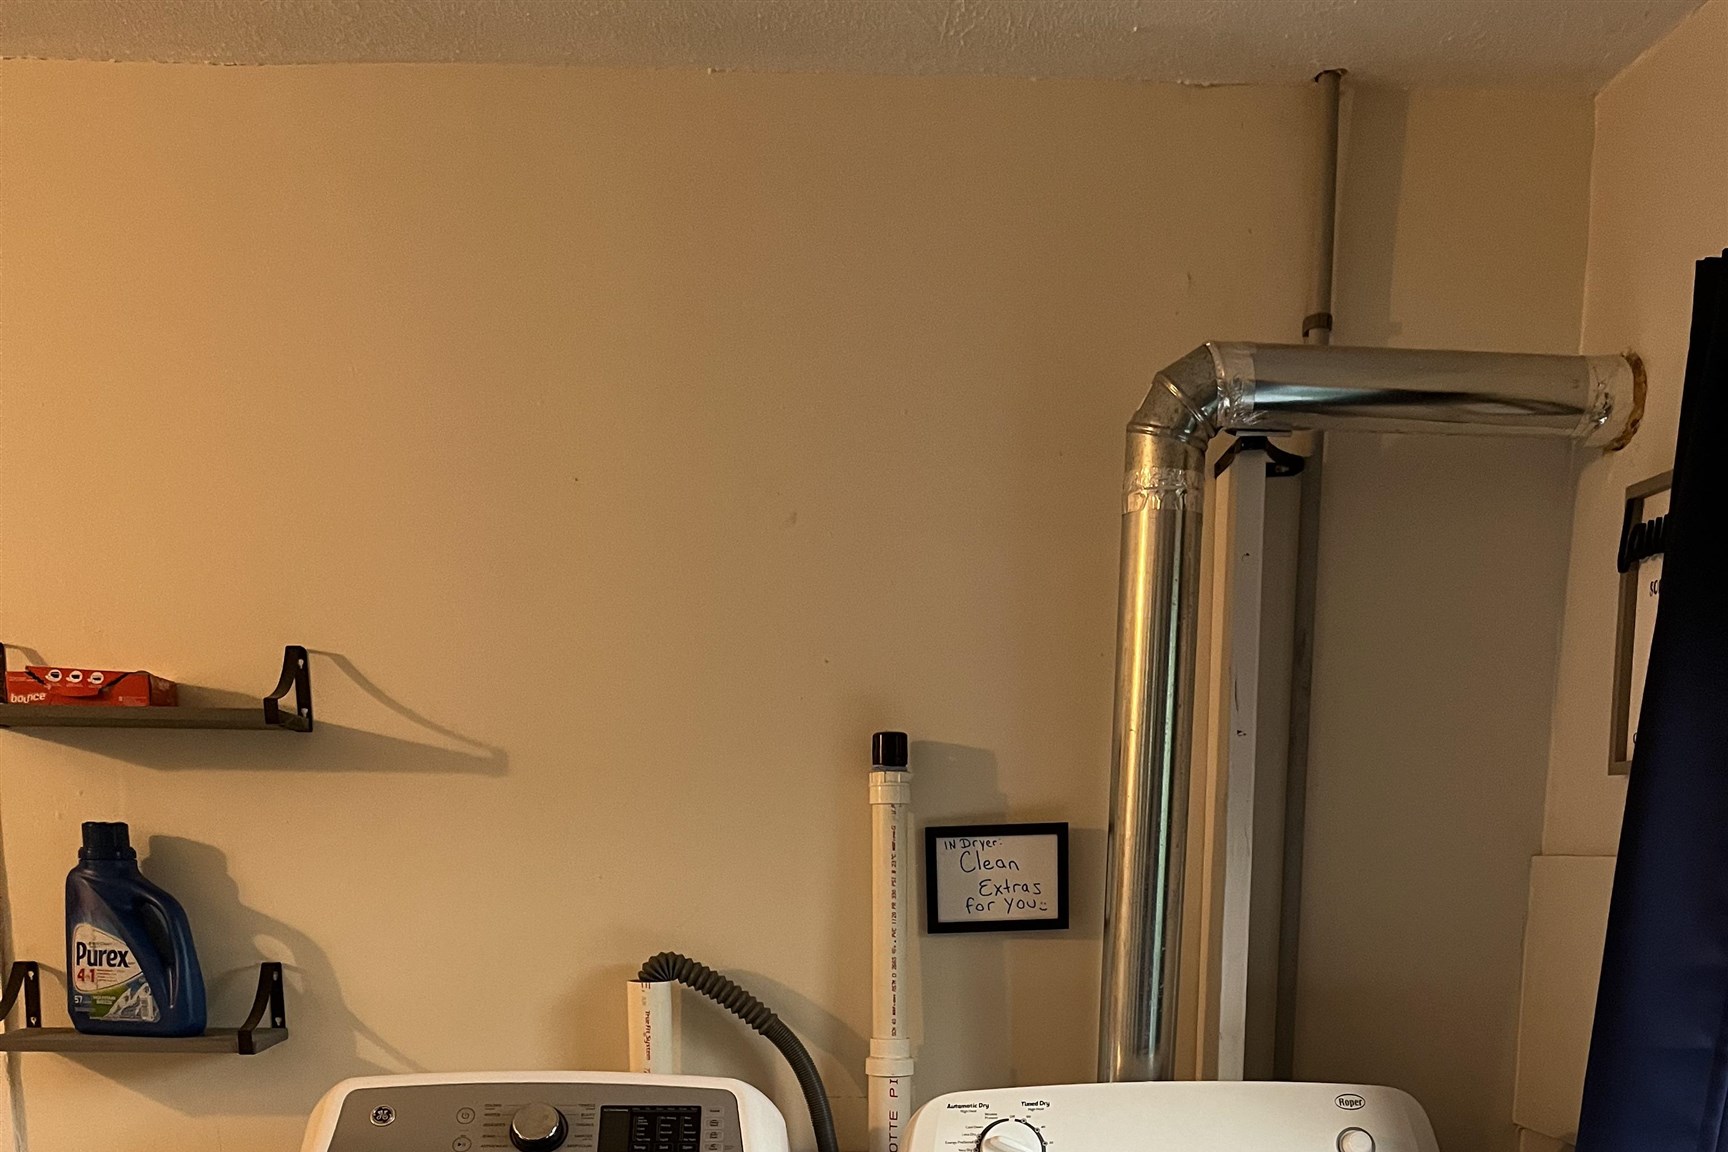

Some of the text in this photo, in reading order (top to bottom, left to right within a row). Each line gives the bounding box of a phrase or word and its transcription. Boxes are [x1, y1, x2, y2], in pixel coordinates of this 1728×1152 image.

[10, 692, 47, 704] bounce
[944, 840, 956, 850] IN
[959, 849, 1020, 873] Clean
[978, 878, 1042, 897] Extras
[965, 896, 995, 914] for
[76, 941, 130, 968] Purex
[947, 1101, 990, 1110] Automatic Dry
[1039, 1100, 1051, 1109] Dry
[1338, 1097, 1363, 1107] Roper
